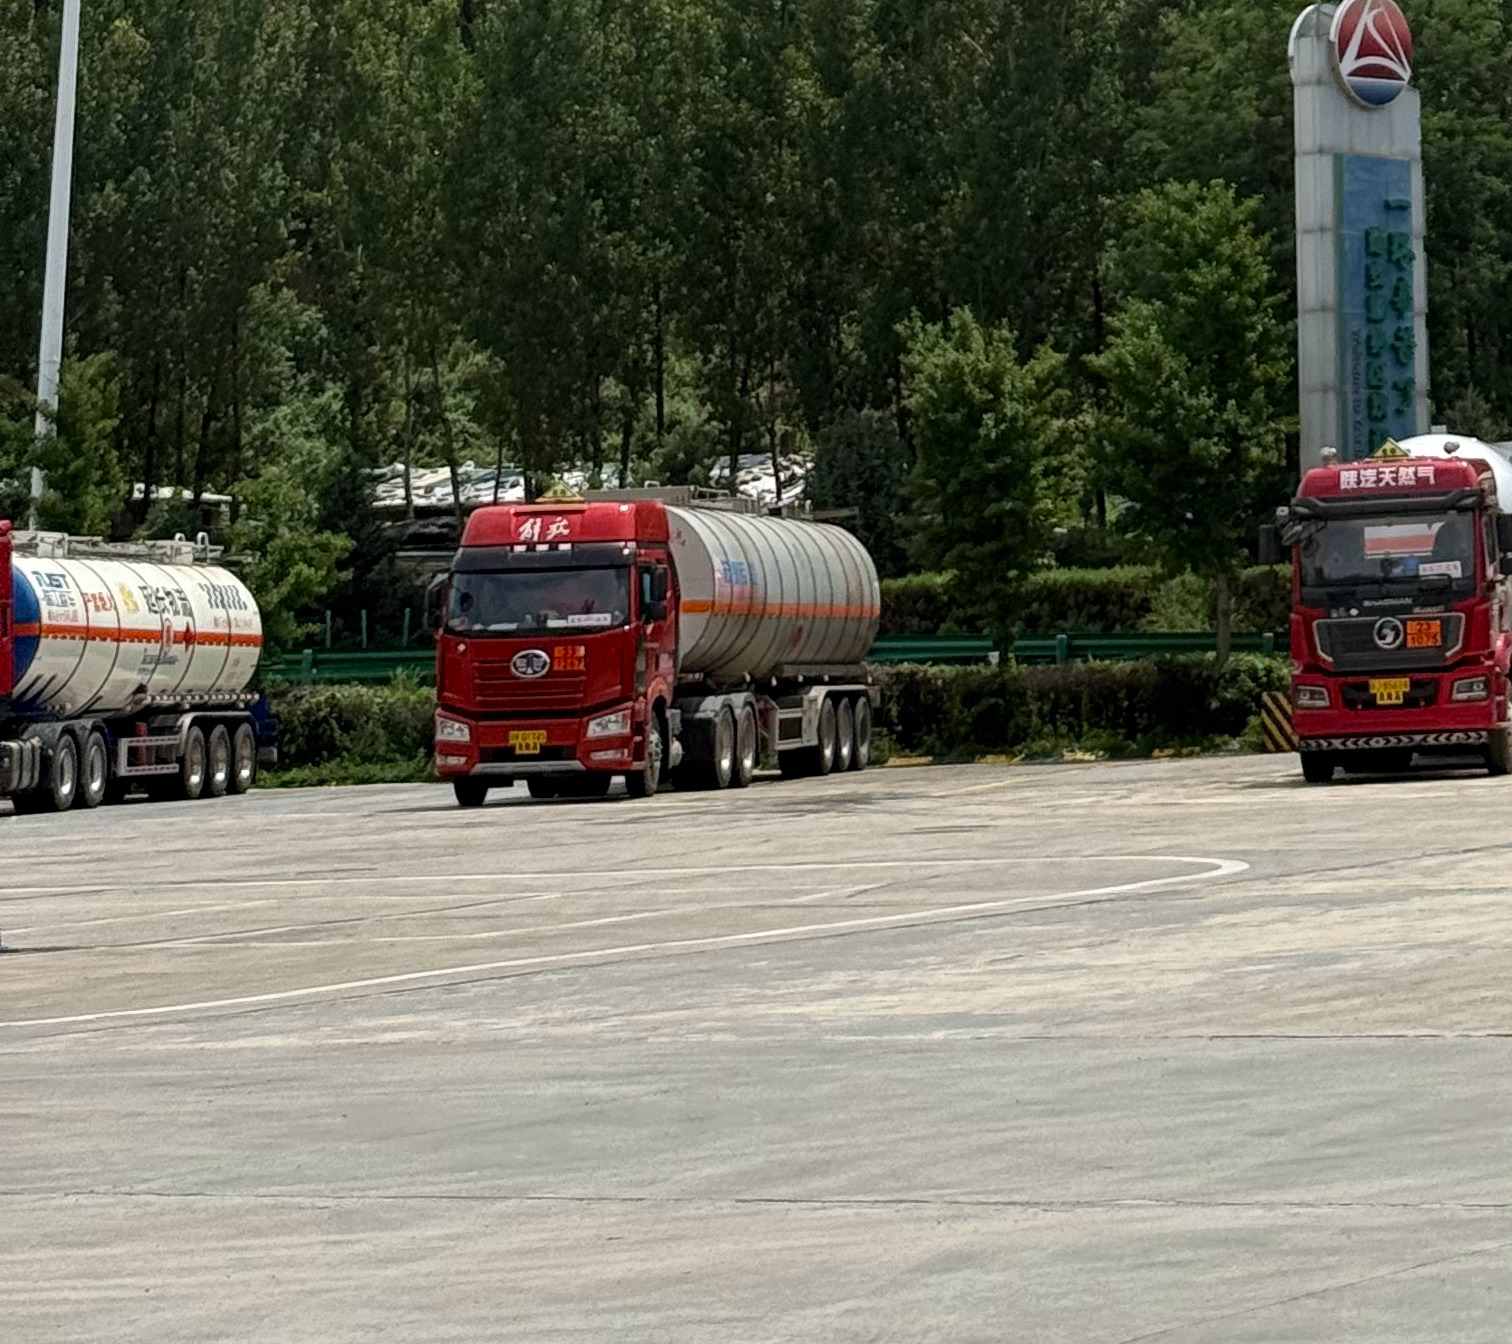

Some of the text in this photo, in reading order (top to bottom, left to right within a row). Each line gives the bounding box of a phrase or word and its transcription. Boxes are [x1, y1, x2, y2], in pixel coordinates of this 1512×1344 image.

[1340, 466, 1436, 490] 陕汽天然气
